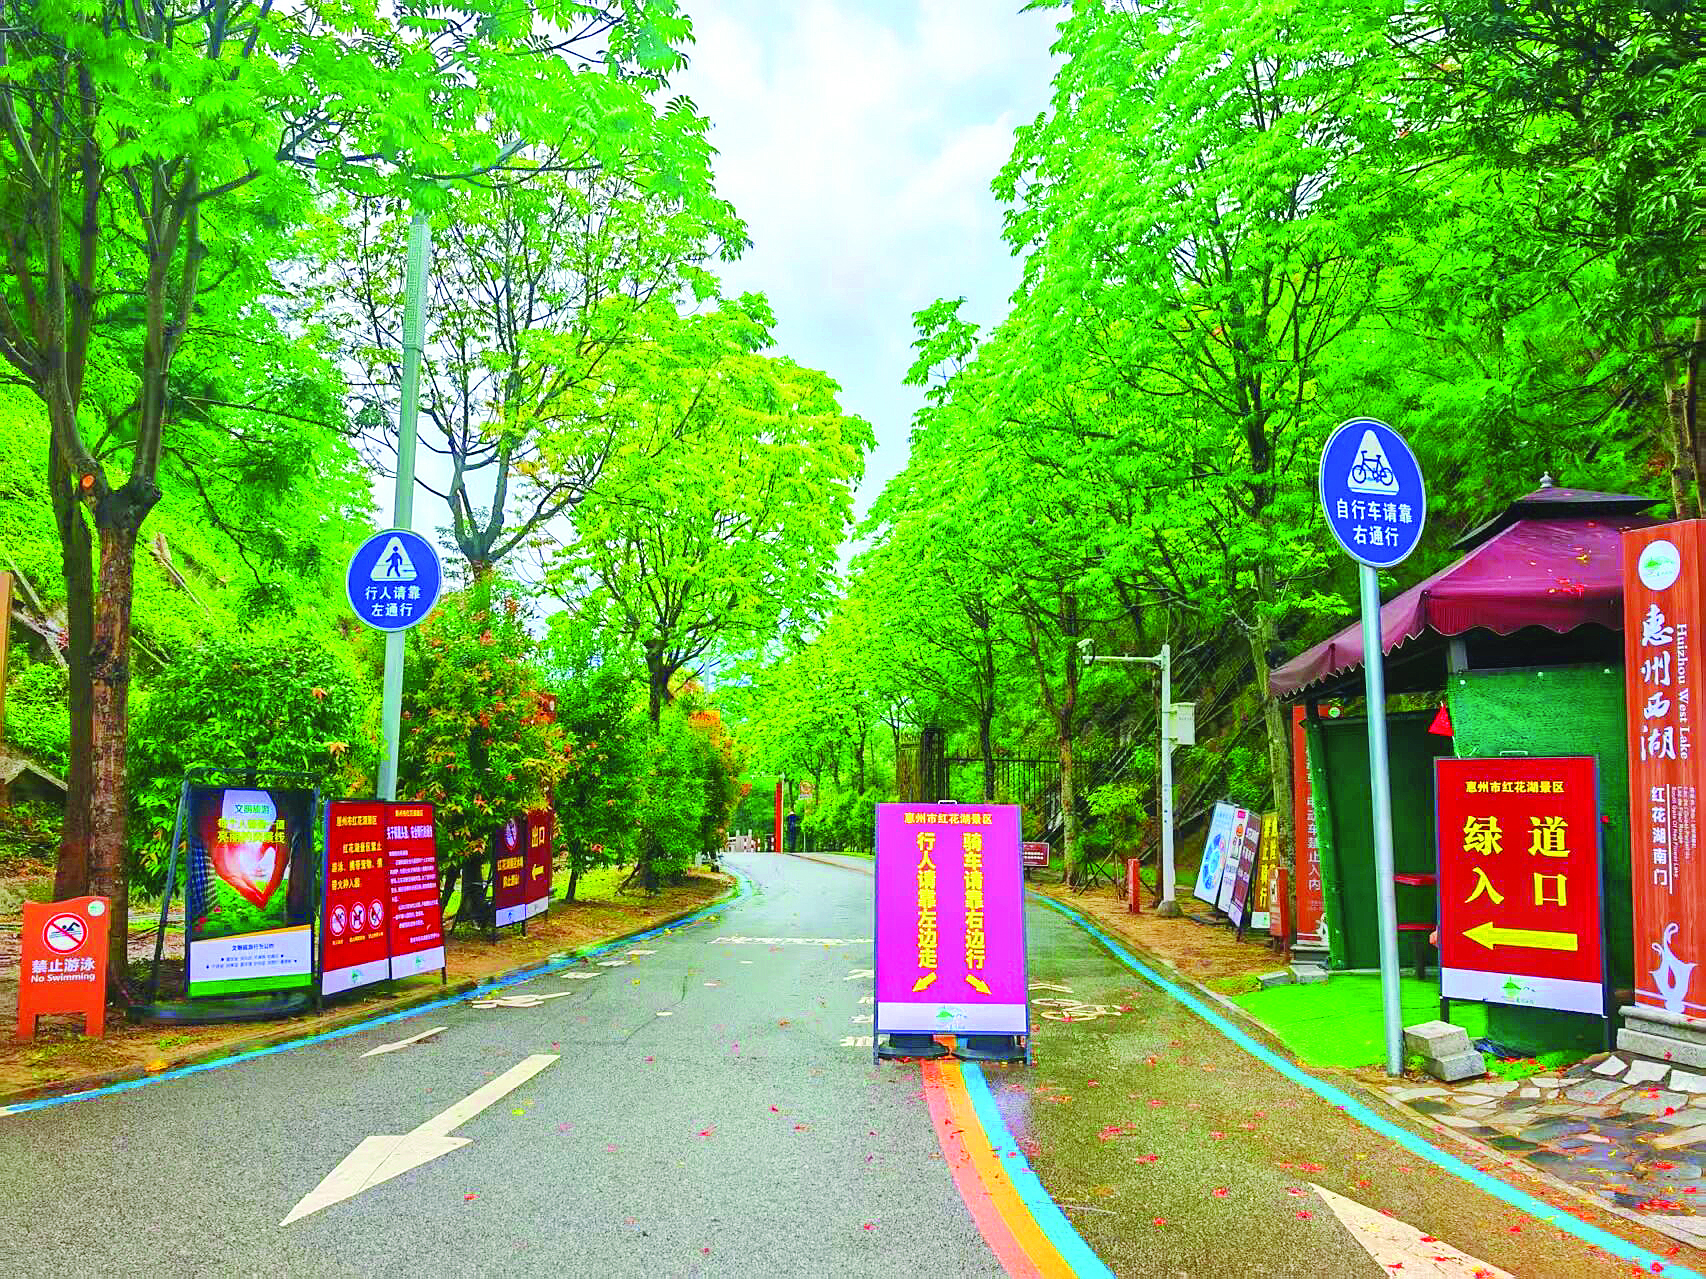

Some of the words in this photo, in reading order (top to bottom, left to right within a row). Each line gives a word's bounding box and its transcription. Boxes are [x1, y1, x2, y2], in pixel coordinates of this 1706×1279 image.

[1336, 497, 1413, 524] 自行车请靠
[1353, 524, 1399, 547] 右通行
[365, 585, 421, 600] 行人请靠
[371, 602, 413, 617] 左通行
[1676, 623, 1688, 685] Huizhou
[1640, 603, 1676, 762] 惠州西湖
[1678, 687, 1689, 723] West
[1680, 726, 1691, 760] Lake
[1465, 780, 1565, 793] 惠州市红花湖景区
[903, 812, 993, 825] 惠州市红花湖景区
[531, 825, 545, 848] 出口
[1463, 815, 1571, 858] 绿道
[1651, 786, 1668, 886] 红花湖南门
[916, 831, 938, 969] 行人请靠左边走
[962, 832, 986, 970] 骑车请靠右边行
[1464, 866, 1568, 907] 入口
[31, 956, 96, 974] 禁止游泳
[31, 973, 45, 983] No
[47, 972, 96, 983] Swimming
